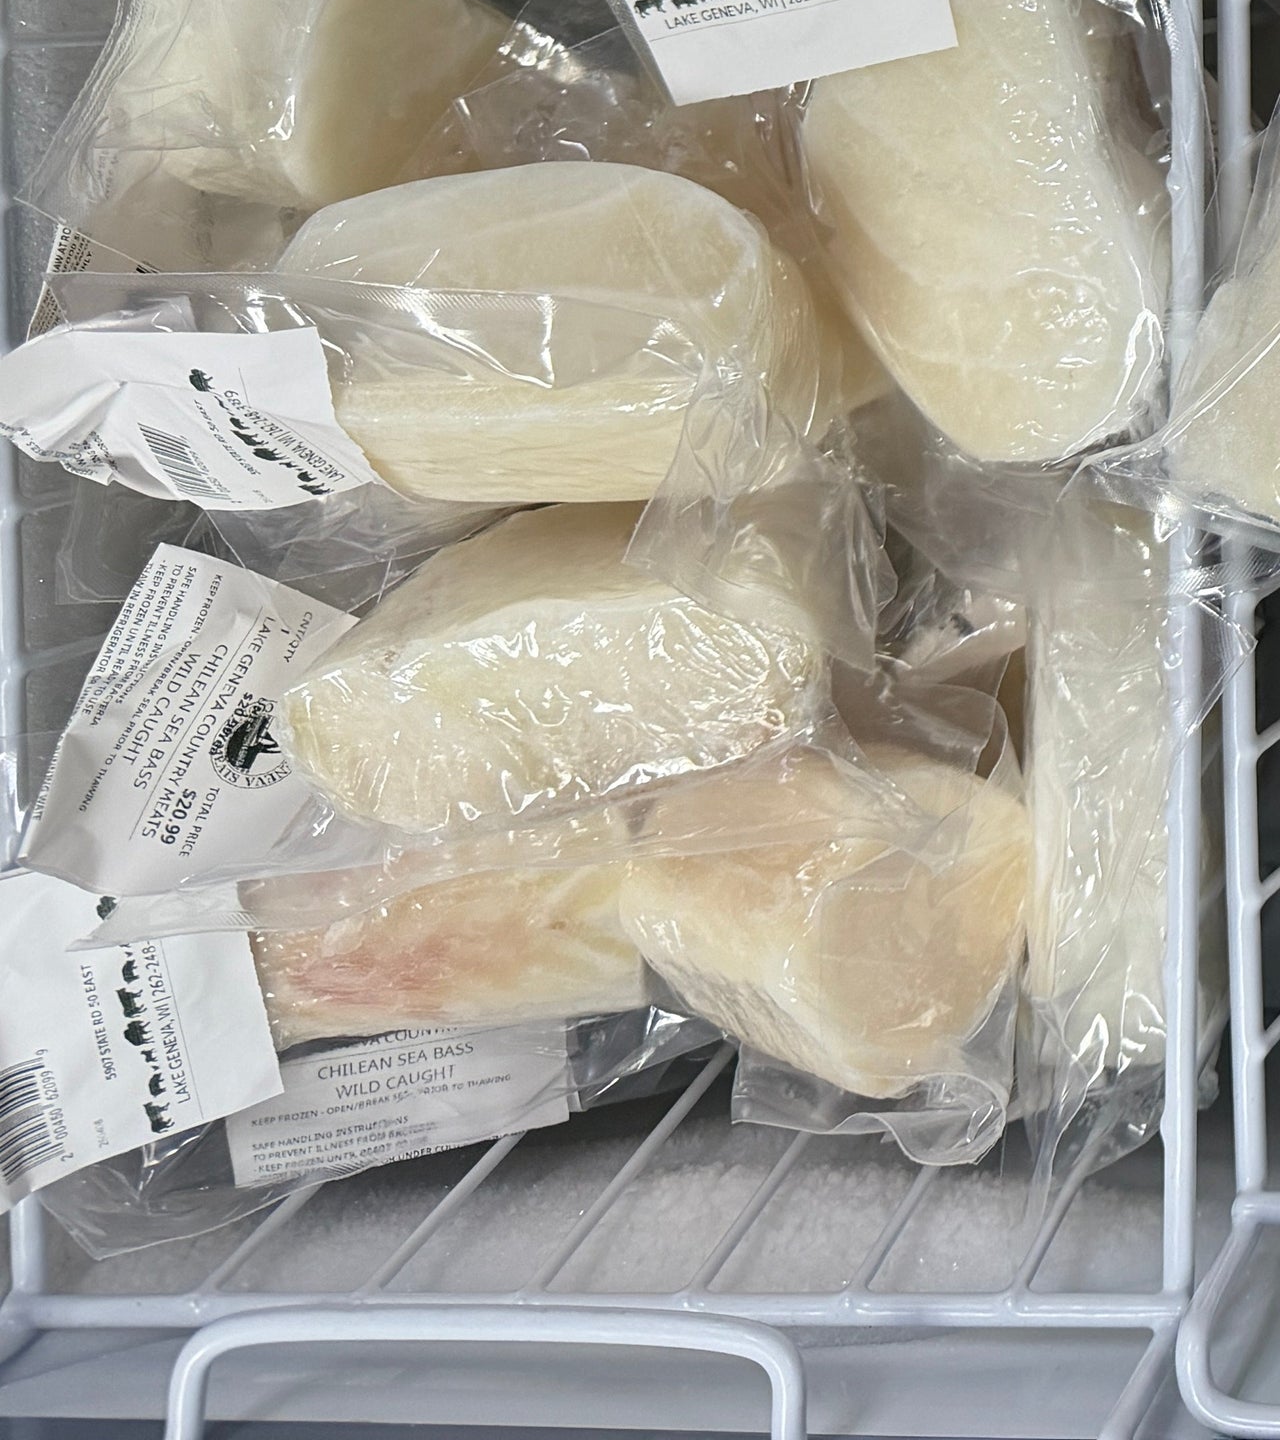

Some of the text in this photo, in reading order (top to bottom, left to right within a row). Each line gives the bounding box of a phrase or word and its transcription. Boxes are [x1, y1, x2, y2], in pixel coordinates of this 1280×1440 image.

[121, 652, 202, 766] WILD CAUGHT
[132, 643, 229, 790] CHILEAN SEA BASS
[159, 787, 197, 845] $20.99
[177, 786, 221, 857] TOTAL PRICE
[152, 1001, 191, 1105] LAKE GENEVA, WI
[316, 1040, 474, 1081] CHILEAN SEA BASS
